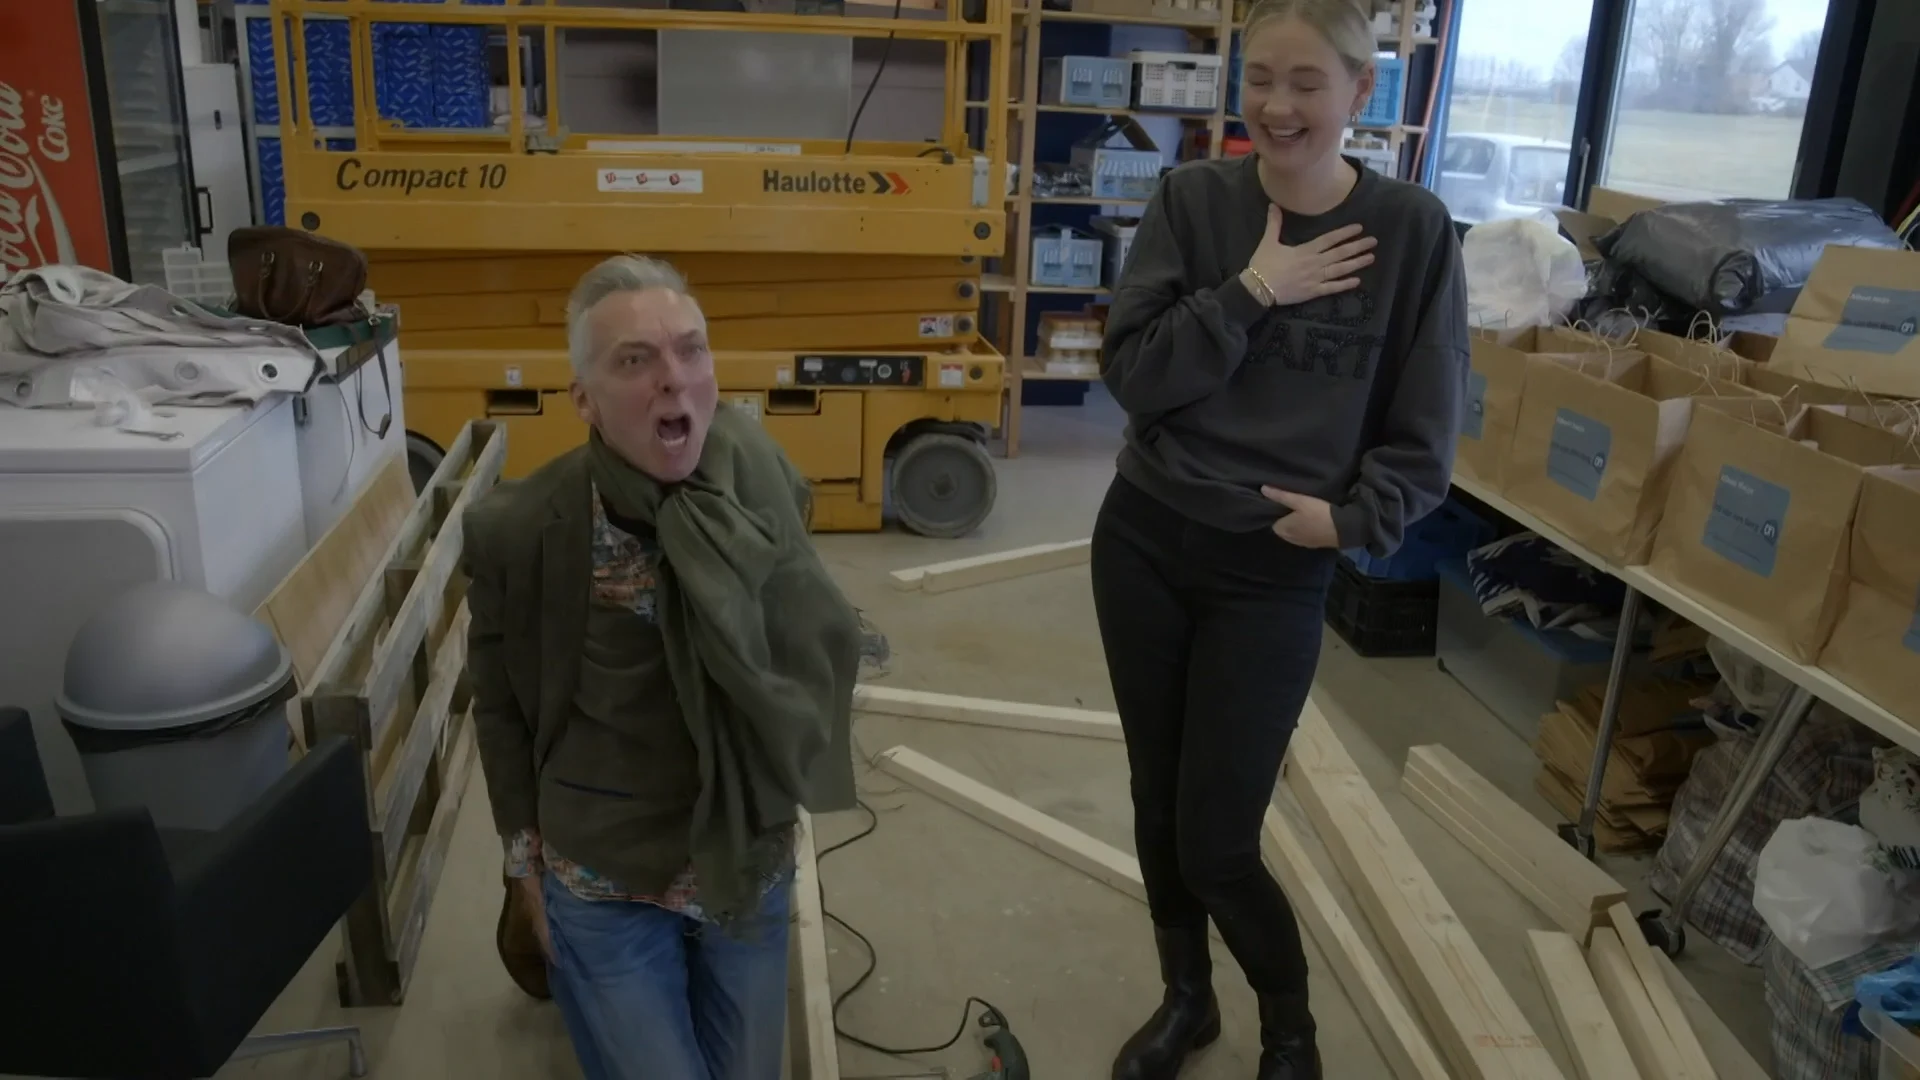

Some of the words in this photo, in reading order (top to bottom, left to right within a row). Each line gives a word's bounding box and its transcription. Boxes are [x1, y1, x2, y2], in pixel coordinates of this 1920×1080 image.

[38, 94, 70, 162] Coke
[336, 157, 468, 196] Compact
[479, 164, 507, 190] 10
[762, 169, 866, 195] Haulotte
[1243, 321, 1387, 379] ART
